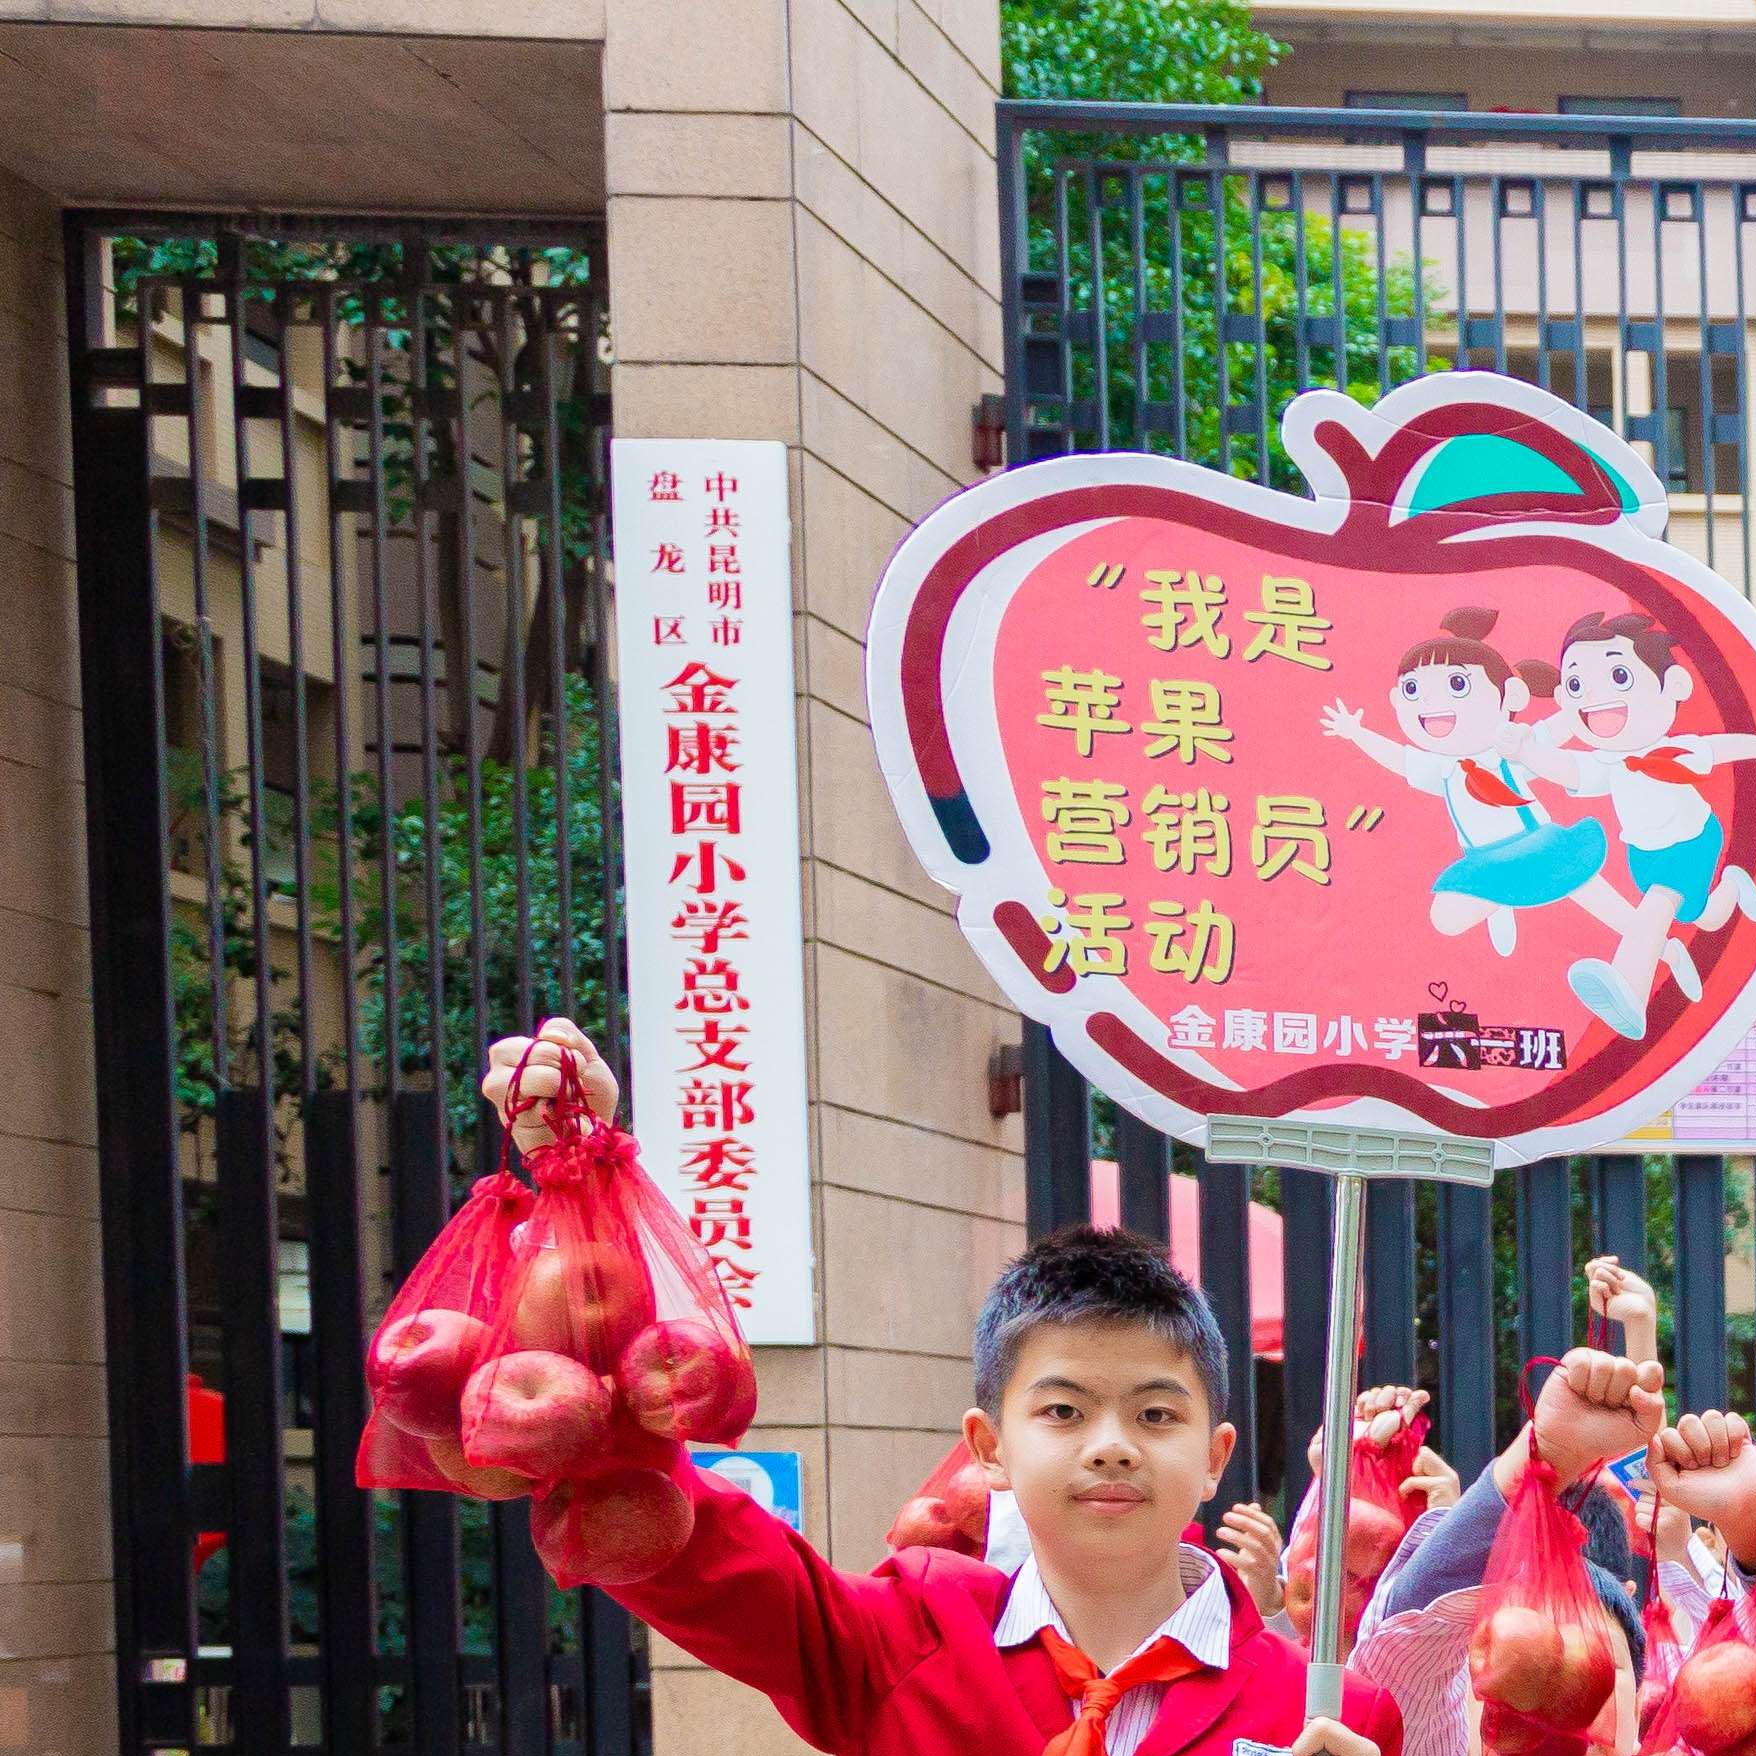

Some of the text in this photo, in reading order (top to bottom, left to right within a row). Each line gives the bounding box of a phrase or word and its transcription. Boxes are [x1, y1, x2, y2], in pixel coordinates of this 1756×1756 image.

[646, 470, 689, 646] 盘龙区
[704, 471, 744, 648] 中共昆明市
[1037, 665, 1235, 766] 苹果
[659, 660, 762, 1311] 金康园小学总支部委员会
[1041, 886, 1237, 985] 活动
